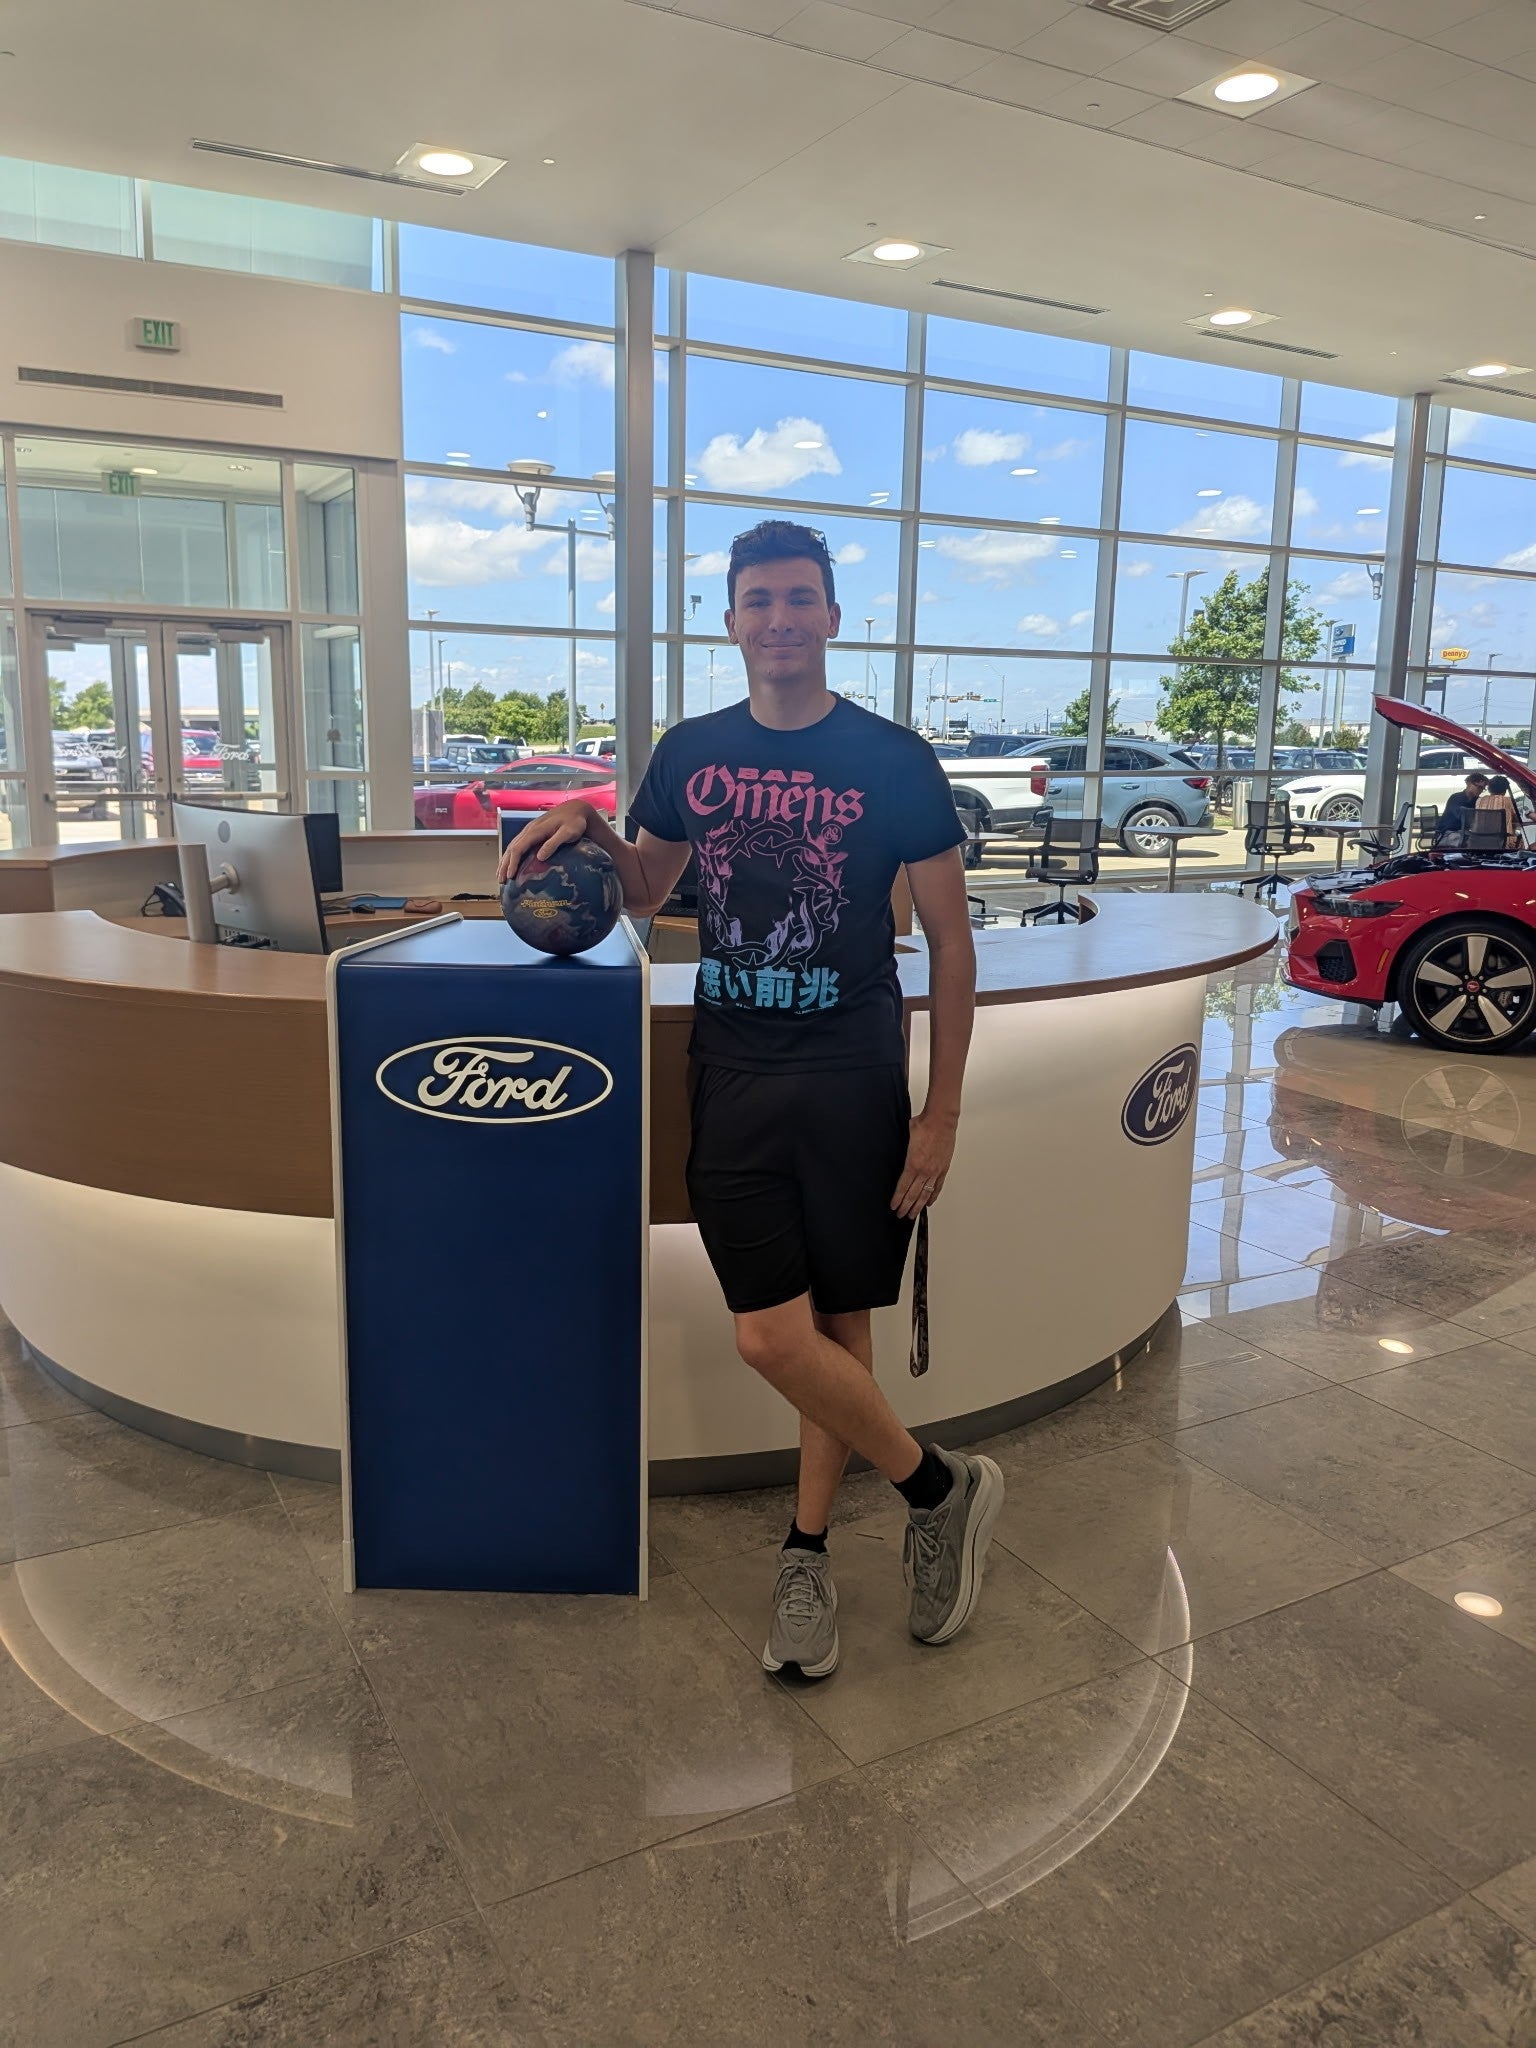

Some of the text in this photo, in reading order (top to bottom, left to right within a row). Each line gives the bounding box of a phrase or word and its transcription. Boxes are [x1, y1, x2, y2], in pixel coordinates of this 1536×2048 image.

[143, 320, 174, 346] EXIT
[109, 473, 135, 496] EXIT
[1442, 650, 1467, 658] Denny's
[86, 741, 127, 759] Ford
[209, 743, 251, 760] Ford
[737, 767, 814, 783] BAD
[686, 764, 866, 827] Omens
[418, 1046, 573, 1110] Ford
[1144, 1060, 1192, 1132] Ford
